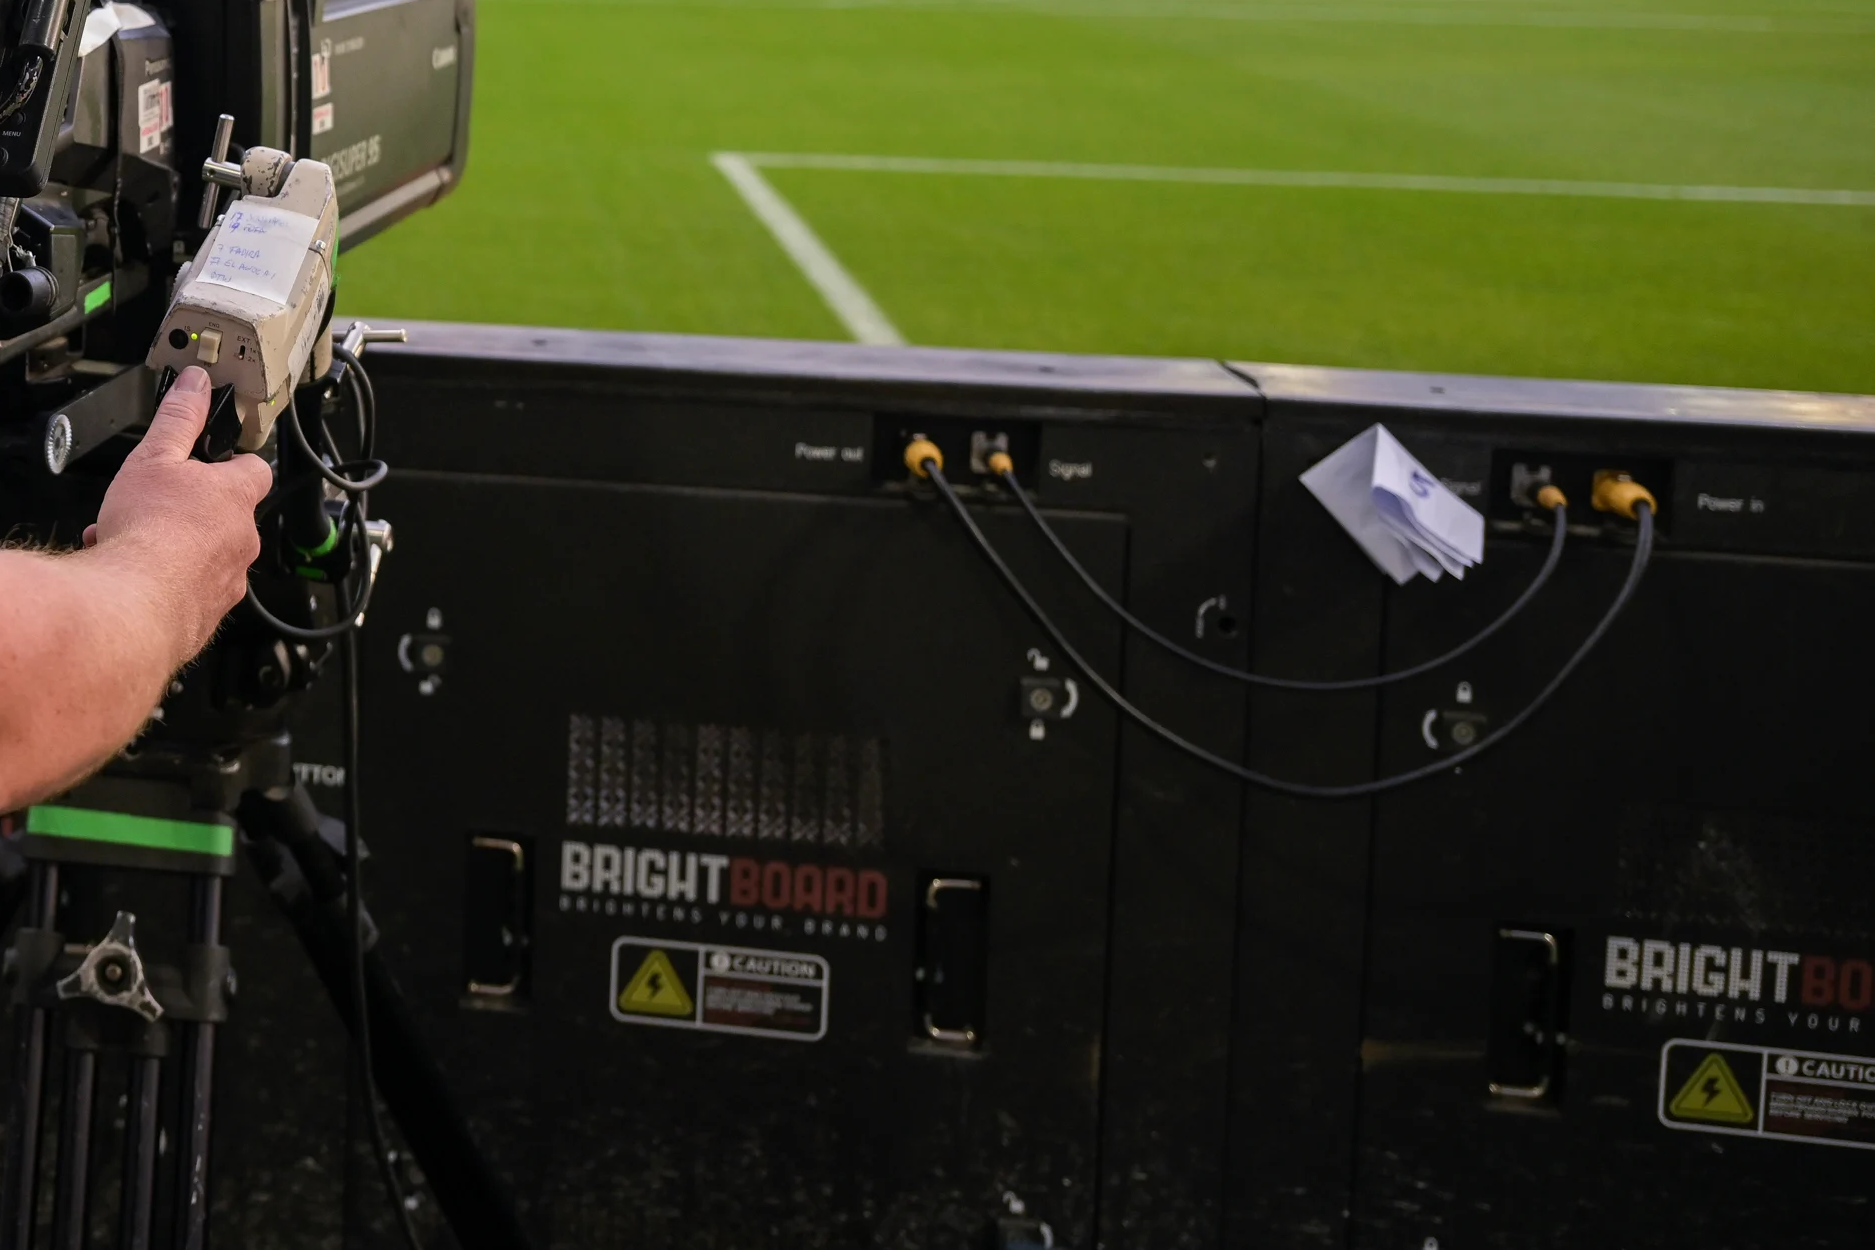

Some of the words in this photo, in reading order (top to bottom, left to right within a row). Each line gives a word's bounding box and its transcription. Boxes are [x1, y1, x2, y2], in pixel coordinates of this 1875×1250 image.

[795, 442, 836, 461] Power
[841, 446, 864, 463] out
[1048, 458, 1093, 481] Signal
[1698, 493, 1743, 513] Power
[1750, 495, 1765, 513] in
[559, 893, 702, 924] BRIGHTENS
[719, 909, 785, 931] YOUR
[803, 917, 889, 943] BRAND
[732, 955, 817, 979] CAUTION
[1602, 993, 1766, 1025] BRIGHTENS
[1788, 1010, 1862, 1034] YOUR
